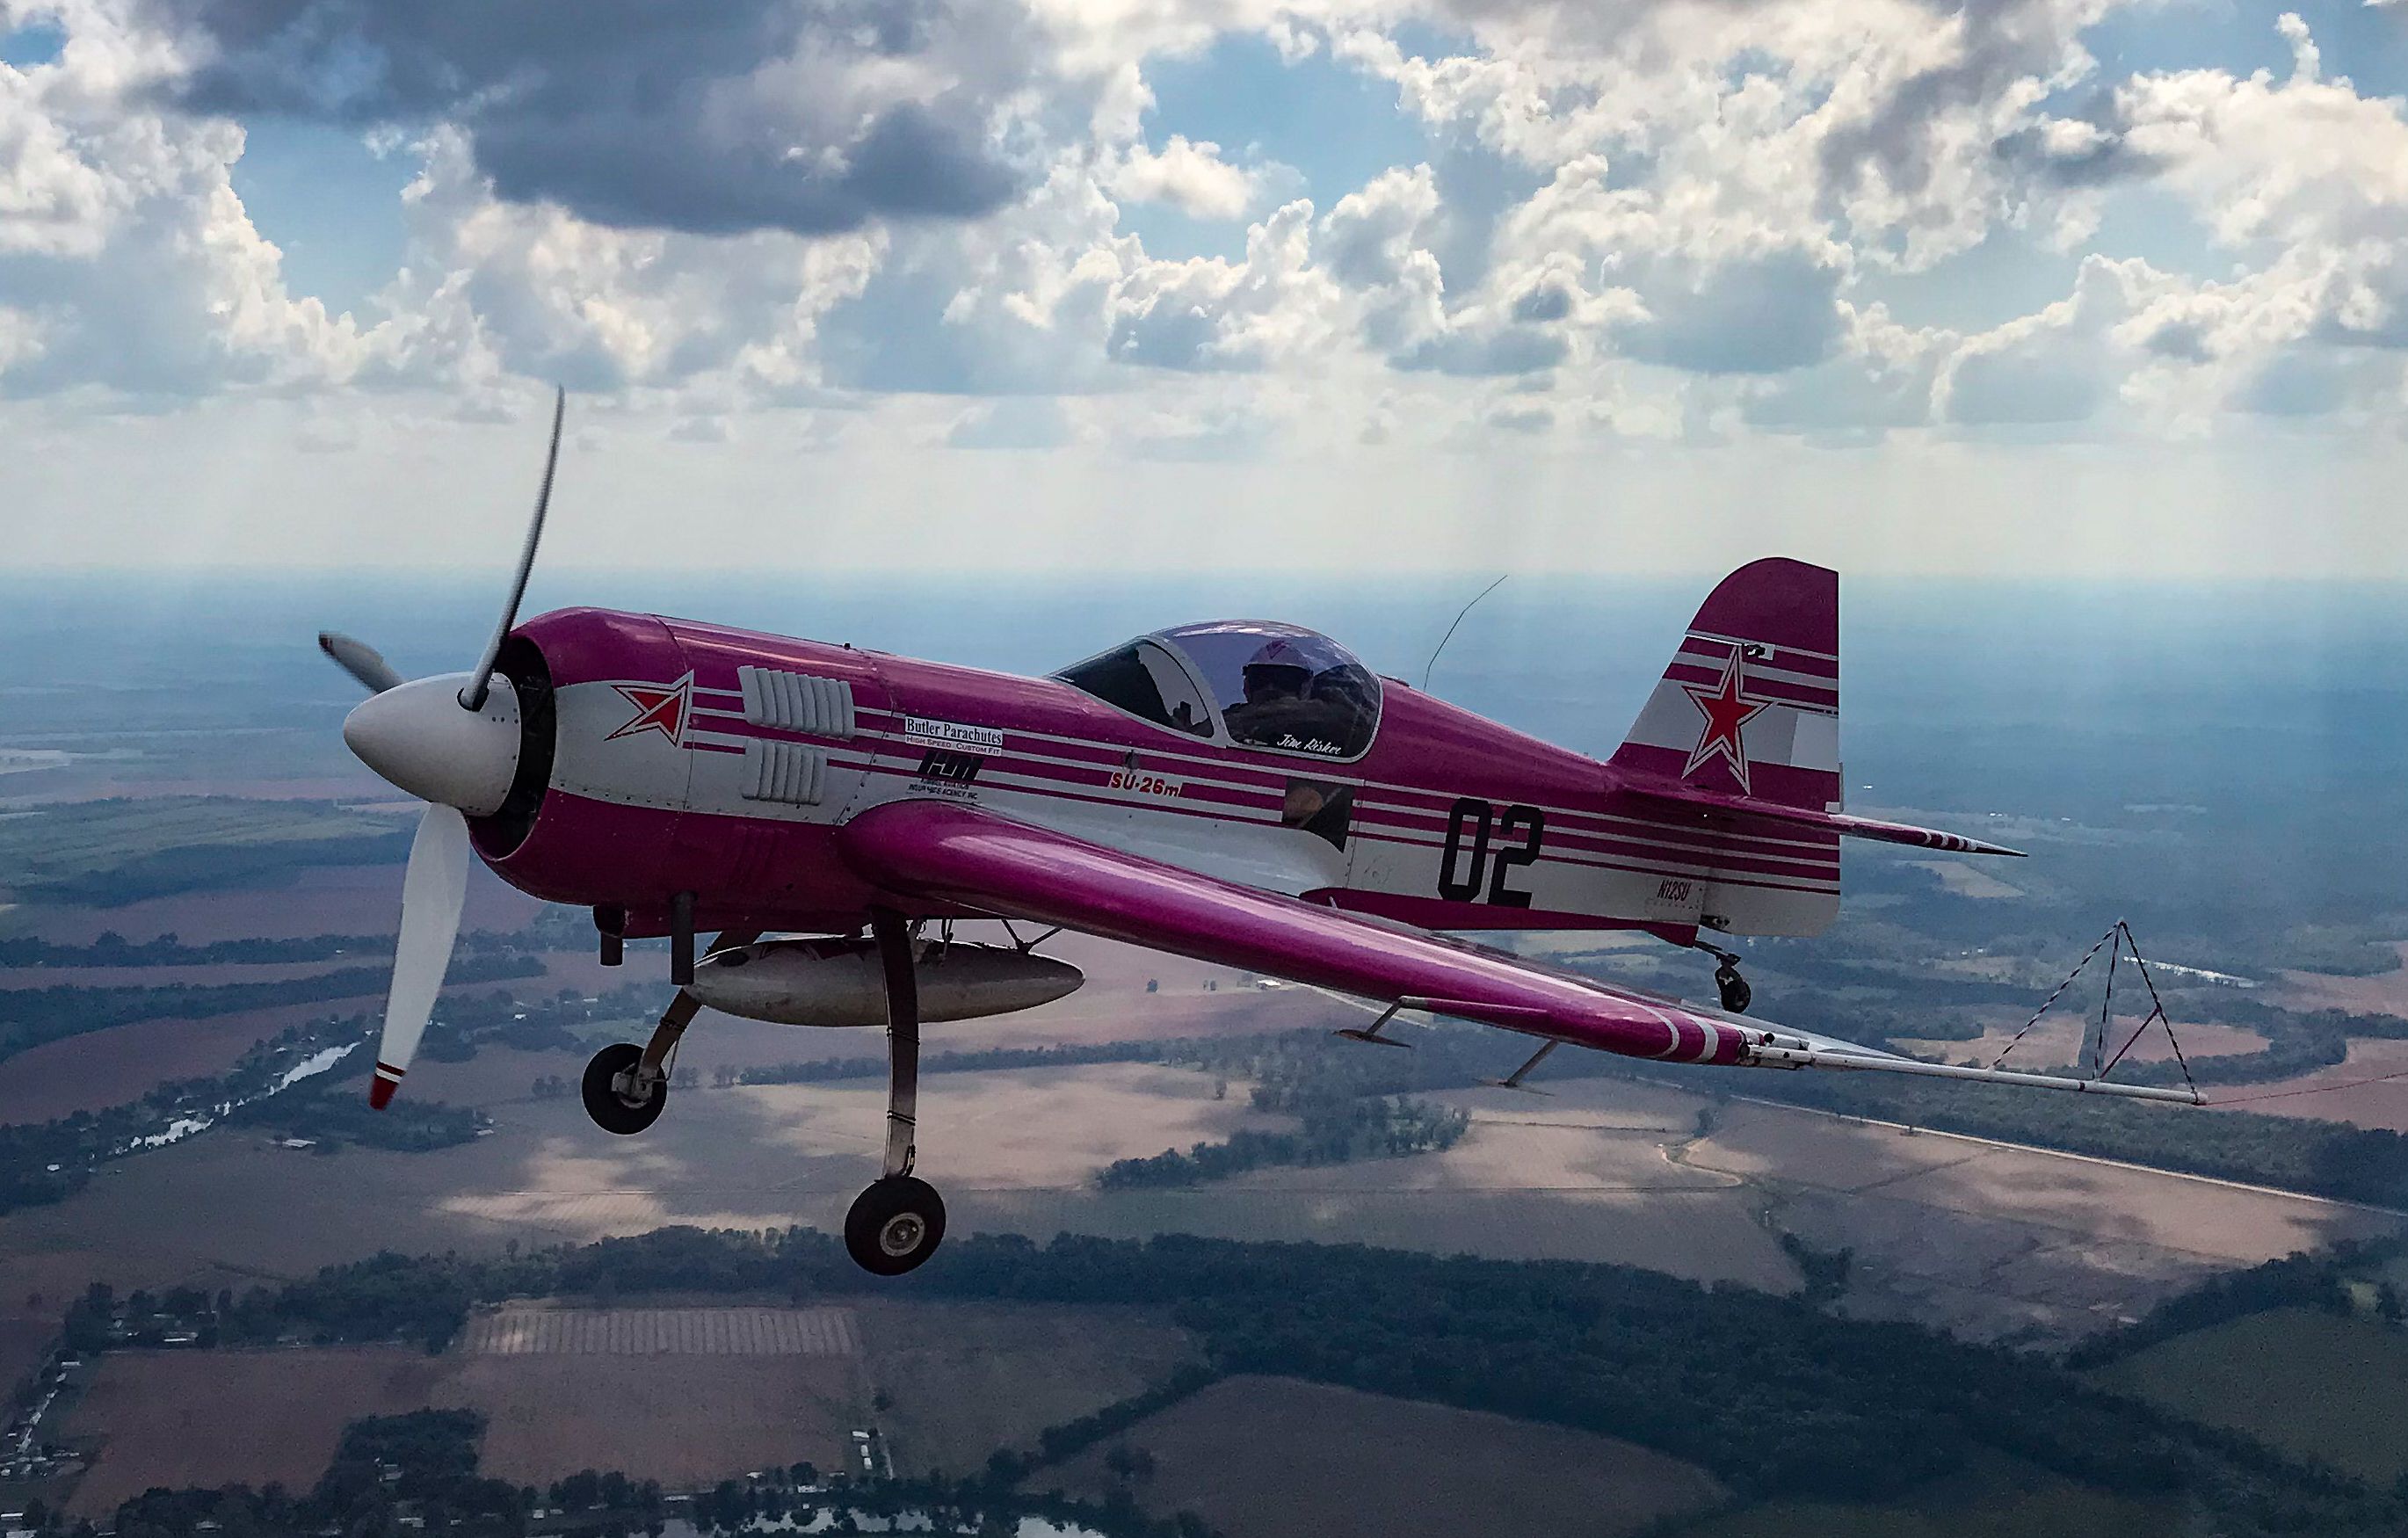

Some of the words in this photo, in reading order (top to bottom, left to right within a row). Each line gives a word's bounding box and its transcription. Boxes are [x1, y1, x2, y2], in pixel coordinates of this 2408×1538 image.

[907, 718, 940, 736] Butler
[944, 723, 1002, 744] Parachutes
[1277, 734, 1302, 749] Jim
[927, 738, 951, 748] SPEED
[956, 743, 987, 753] CUSTOM
[1438, 797, 1543, 909] 02
[1657, 880, 1692, 902] N12SU
